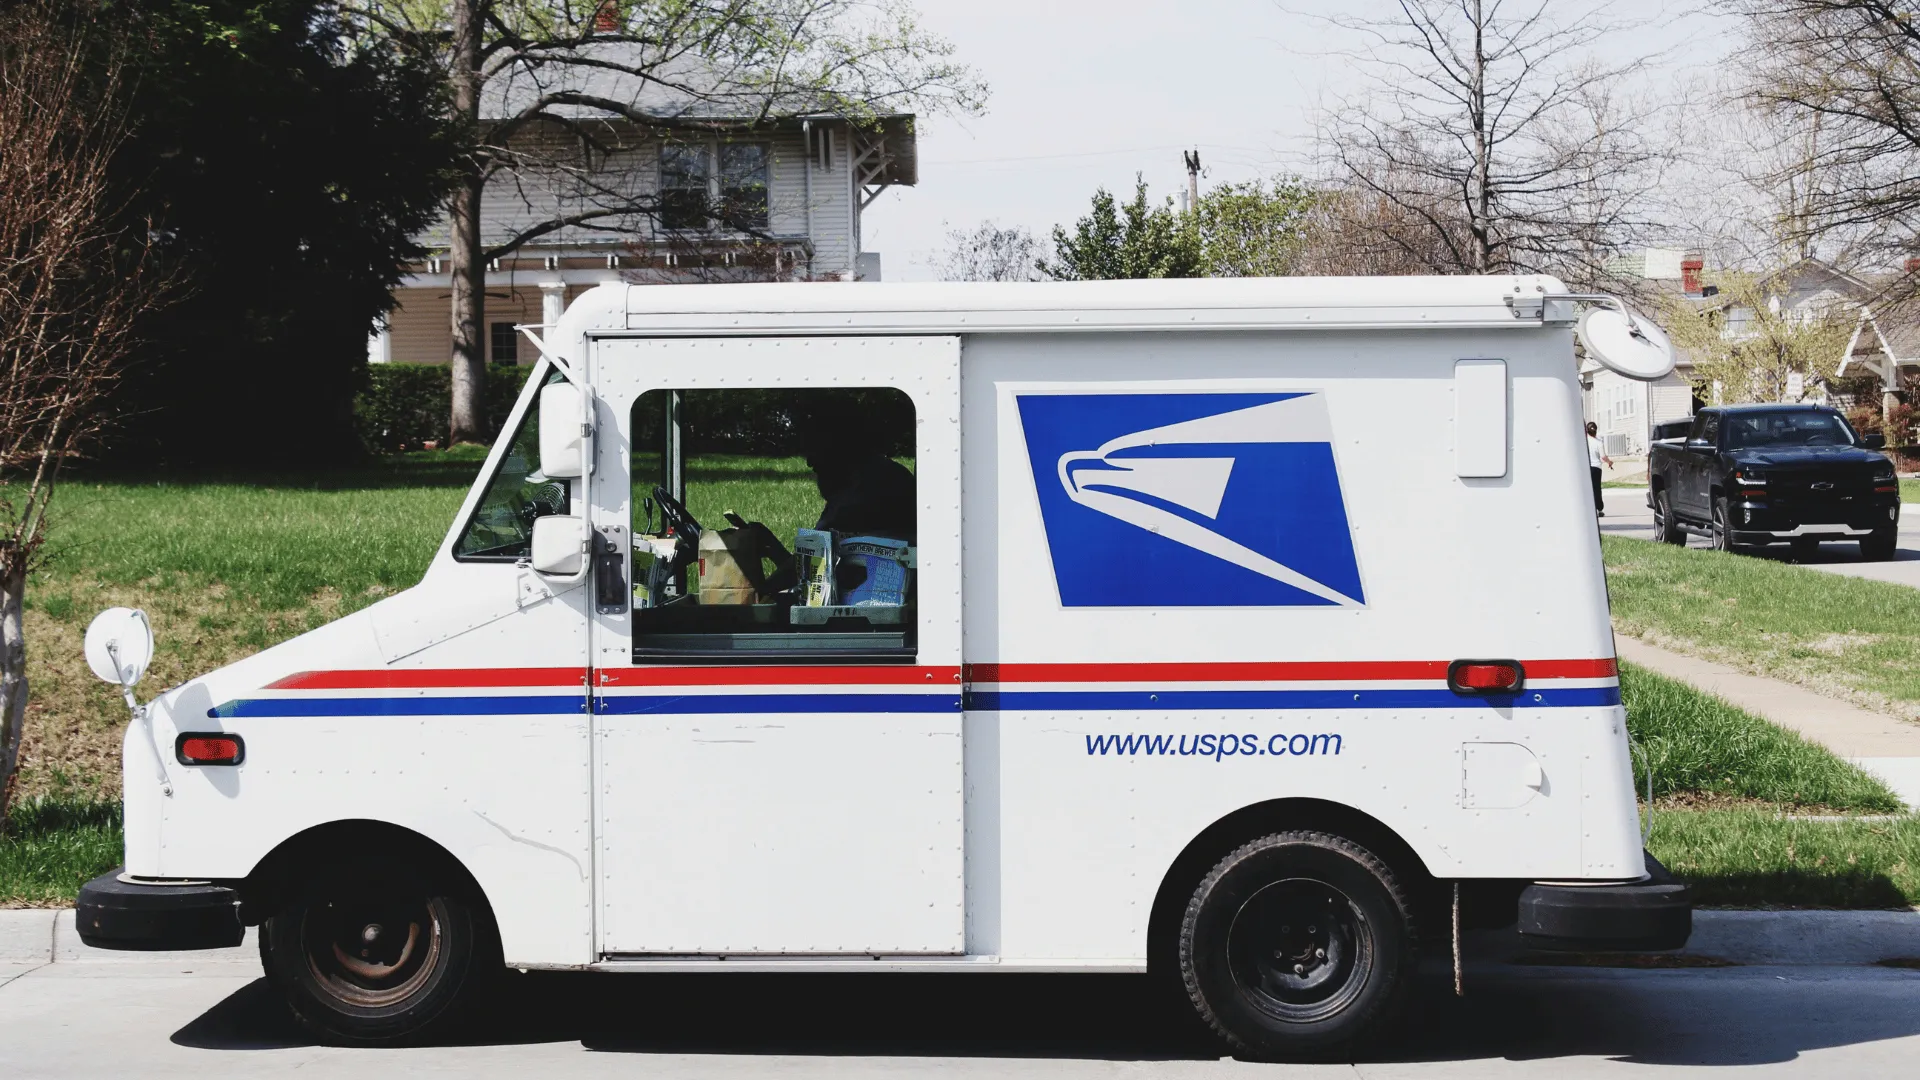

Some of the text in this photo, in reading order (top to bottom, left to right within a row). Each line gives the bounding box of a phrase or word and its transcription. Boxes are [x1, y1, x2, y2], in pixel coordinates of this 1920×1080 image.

[848, 544, 896, 557] NORTHERN BREWER
[1086, 733, 1342, 762] www.usps.com
